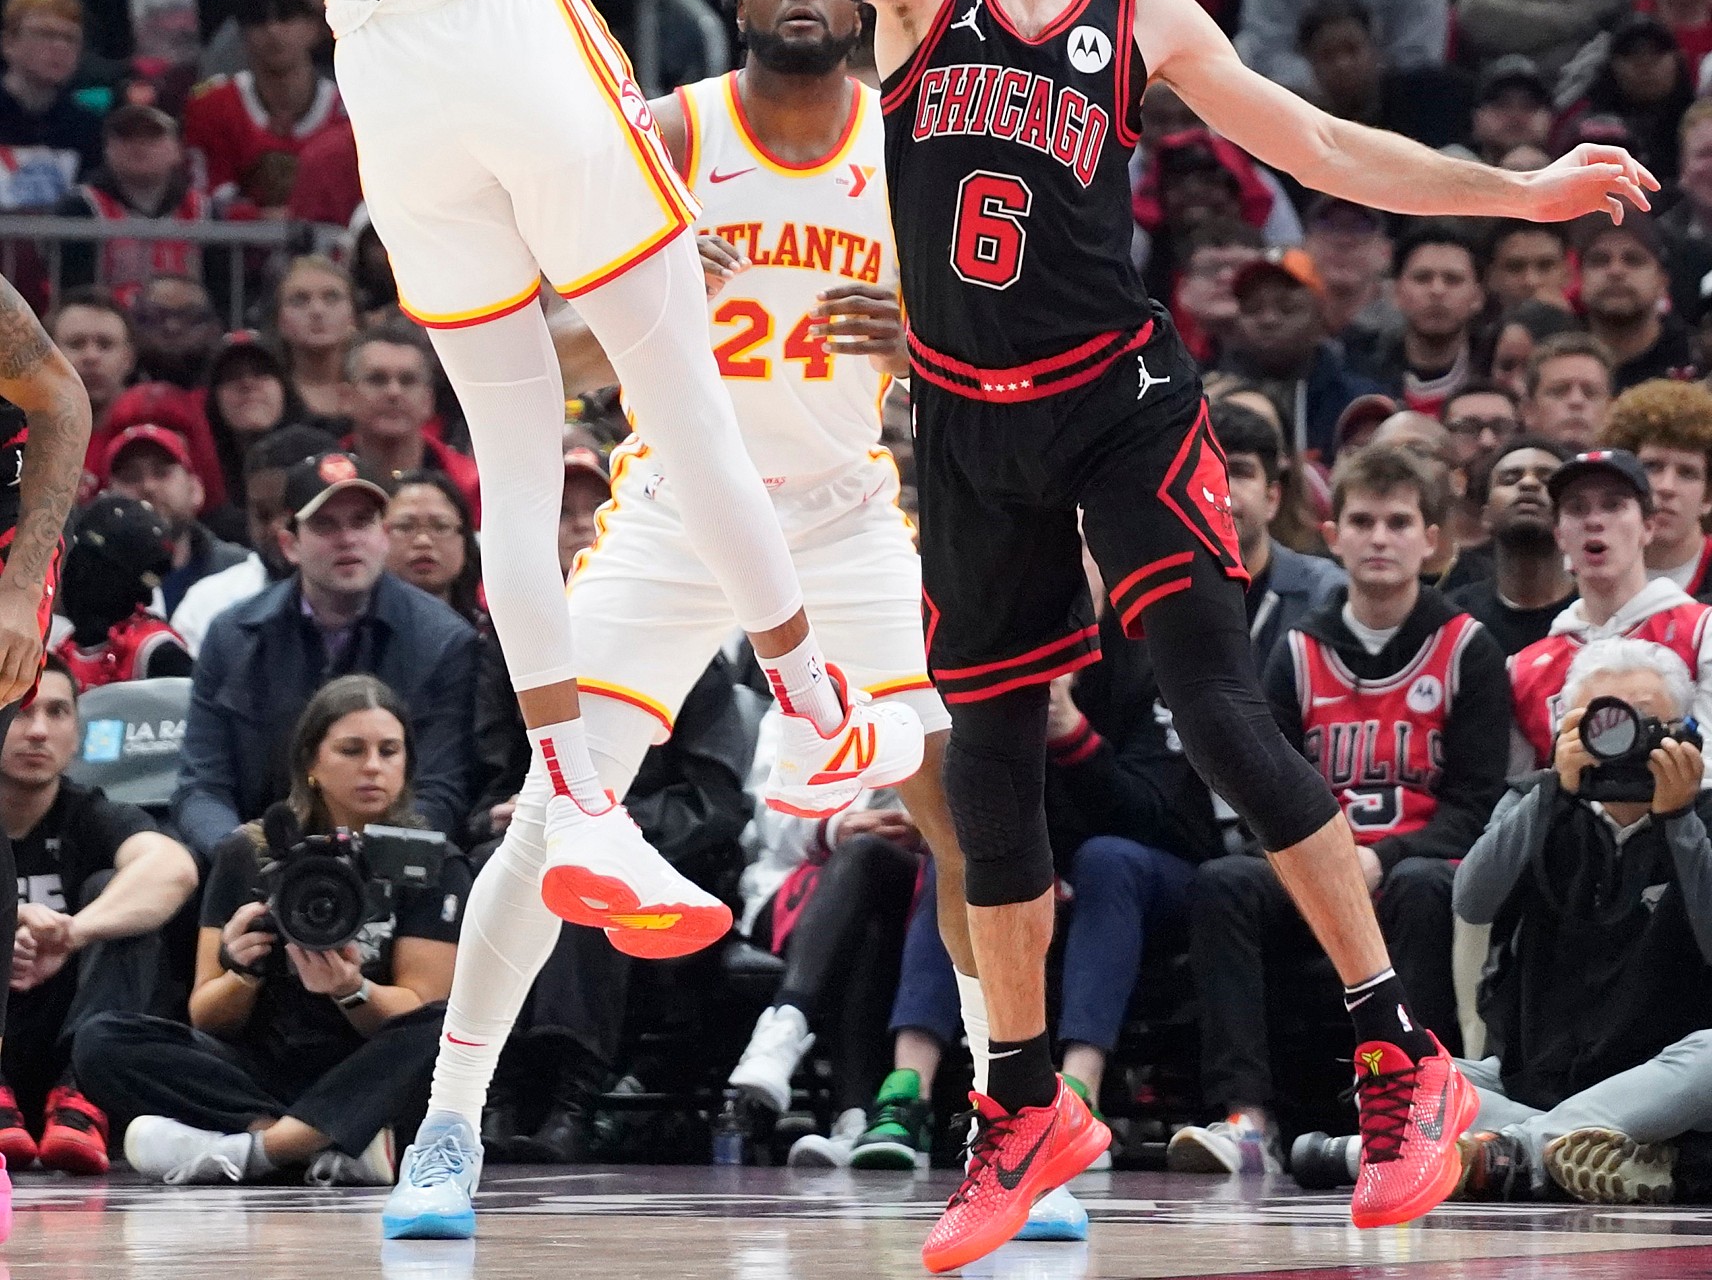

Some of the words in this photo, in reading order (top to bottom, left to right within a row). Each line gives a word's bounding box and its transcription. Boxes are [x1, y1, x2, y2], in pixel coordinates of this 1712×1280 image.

[912, 64, 1109, 188] CHICAGO
[697, 220, 882, 284] TLANTA
[950, 169, 1033, 290] 6
[712, 297, 837, 382] 24
[125, 721, 155, 740] LA
